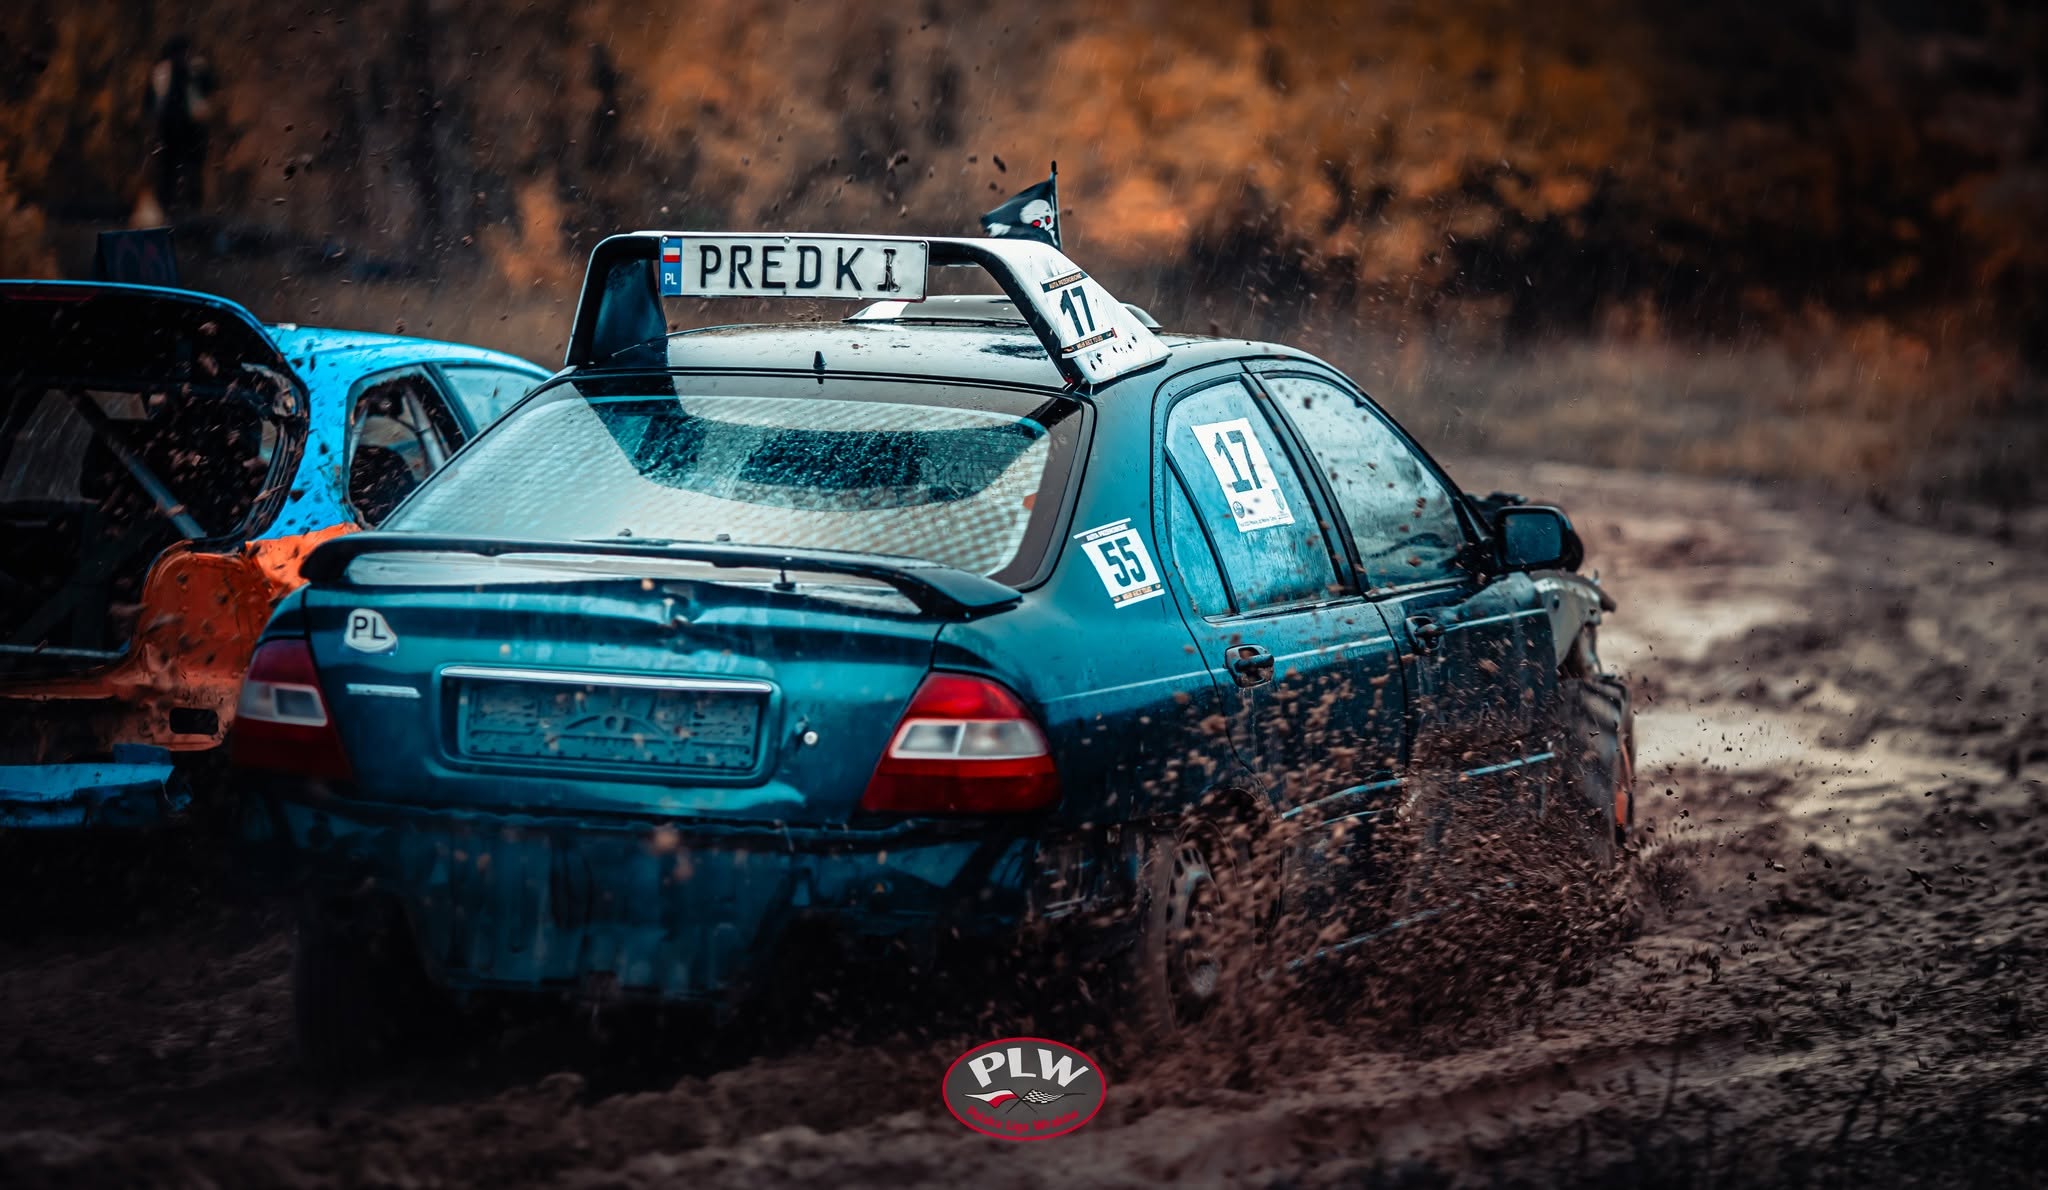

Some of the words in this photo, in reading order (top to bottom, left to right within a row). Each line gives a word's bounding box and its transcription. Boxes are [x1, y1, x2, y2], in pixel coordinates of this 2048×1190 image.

[664, 272, 677, 285] PL
[700, 245, 900, 292] PREDKI
[1060, 285, 1095, 338] 17
[1214, 430, 1262, 493] 17
[1098, 536, 1146, 587] 55
[352, 616, 387, 640] PL
